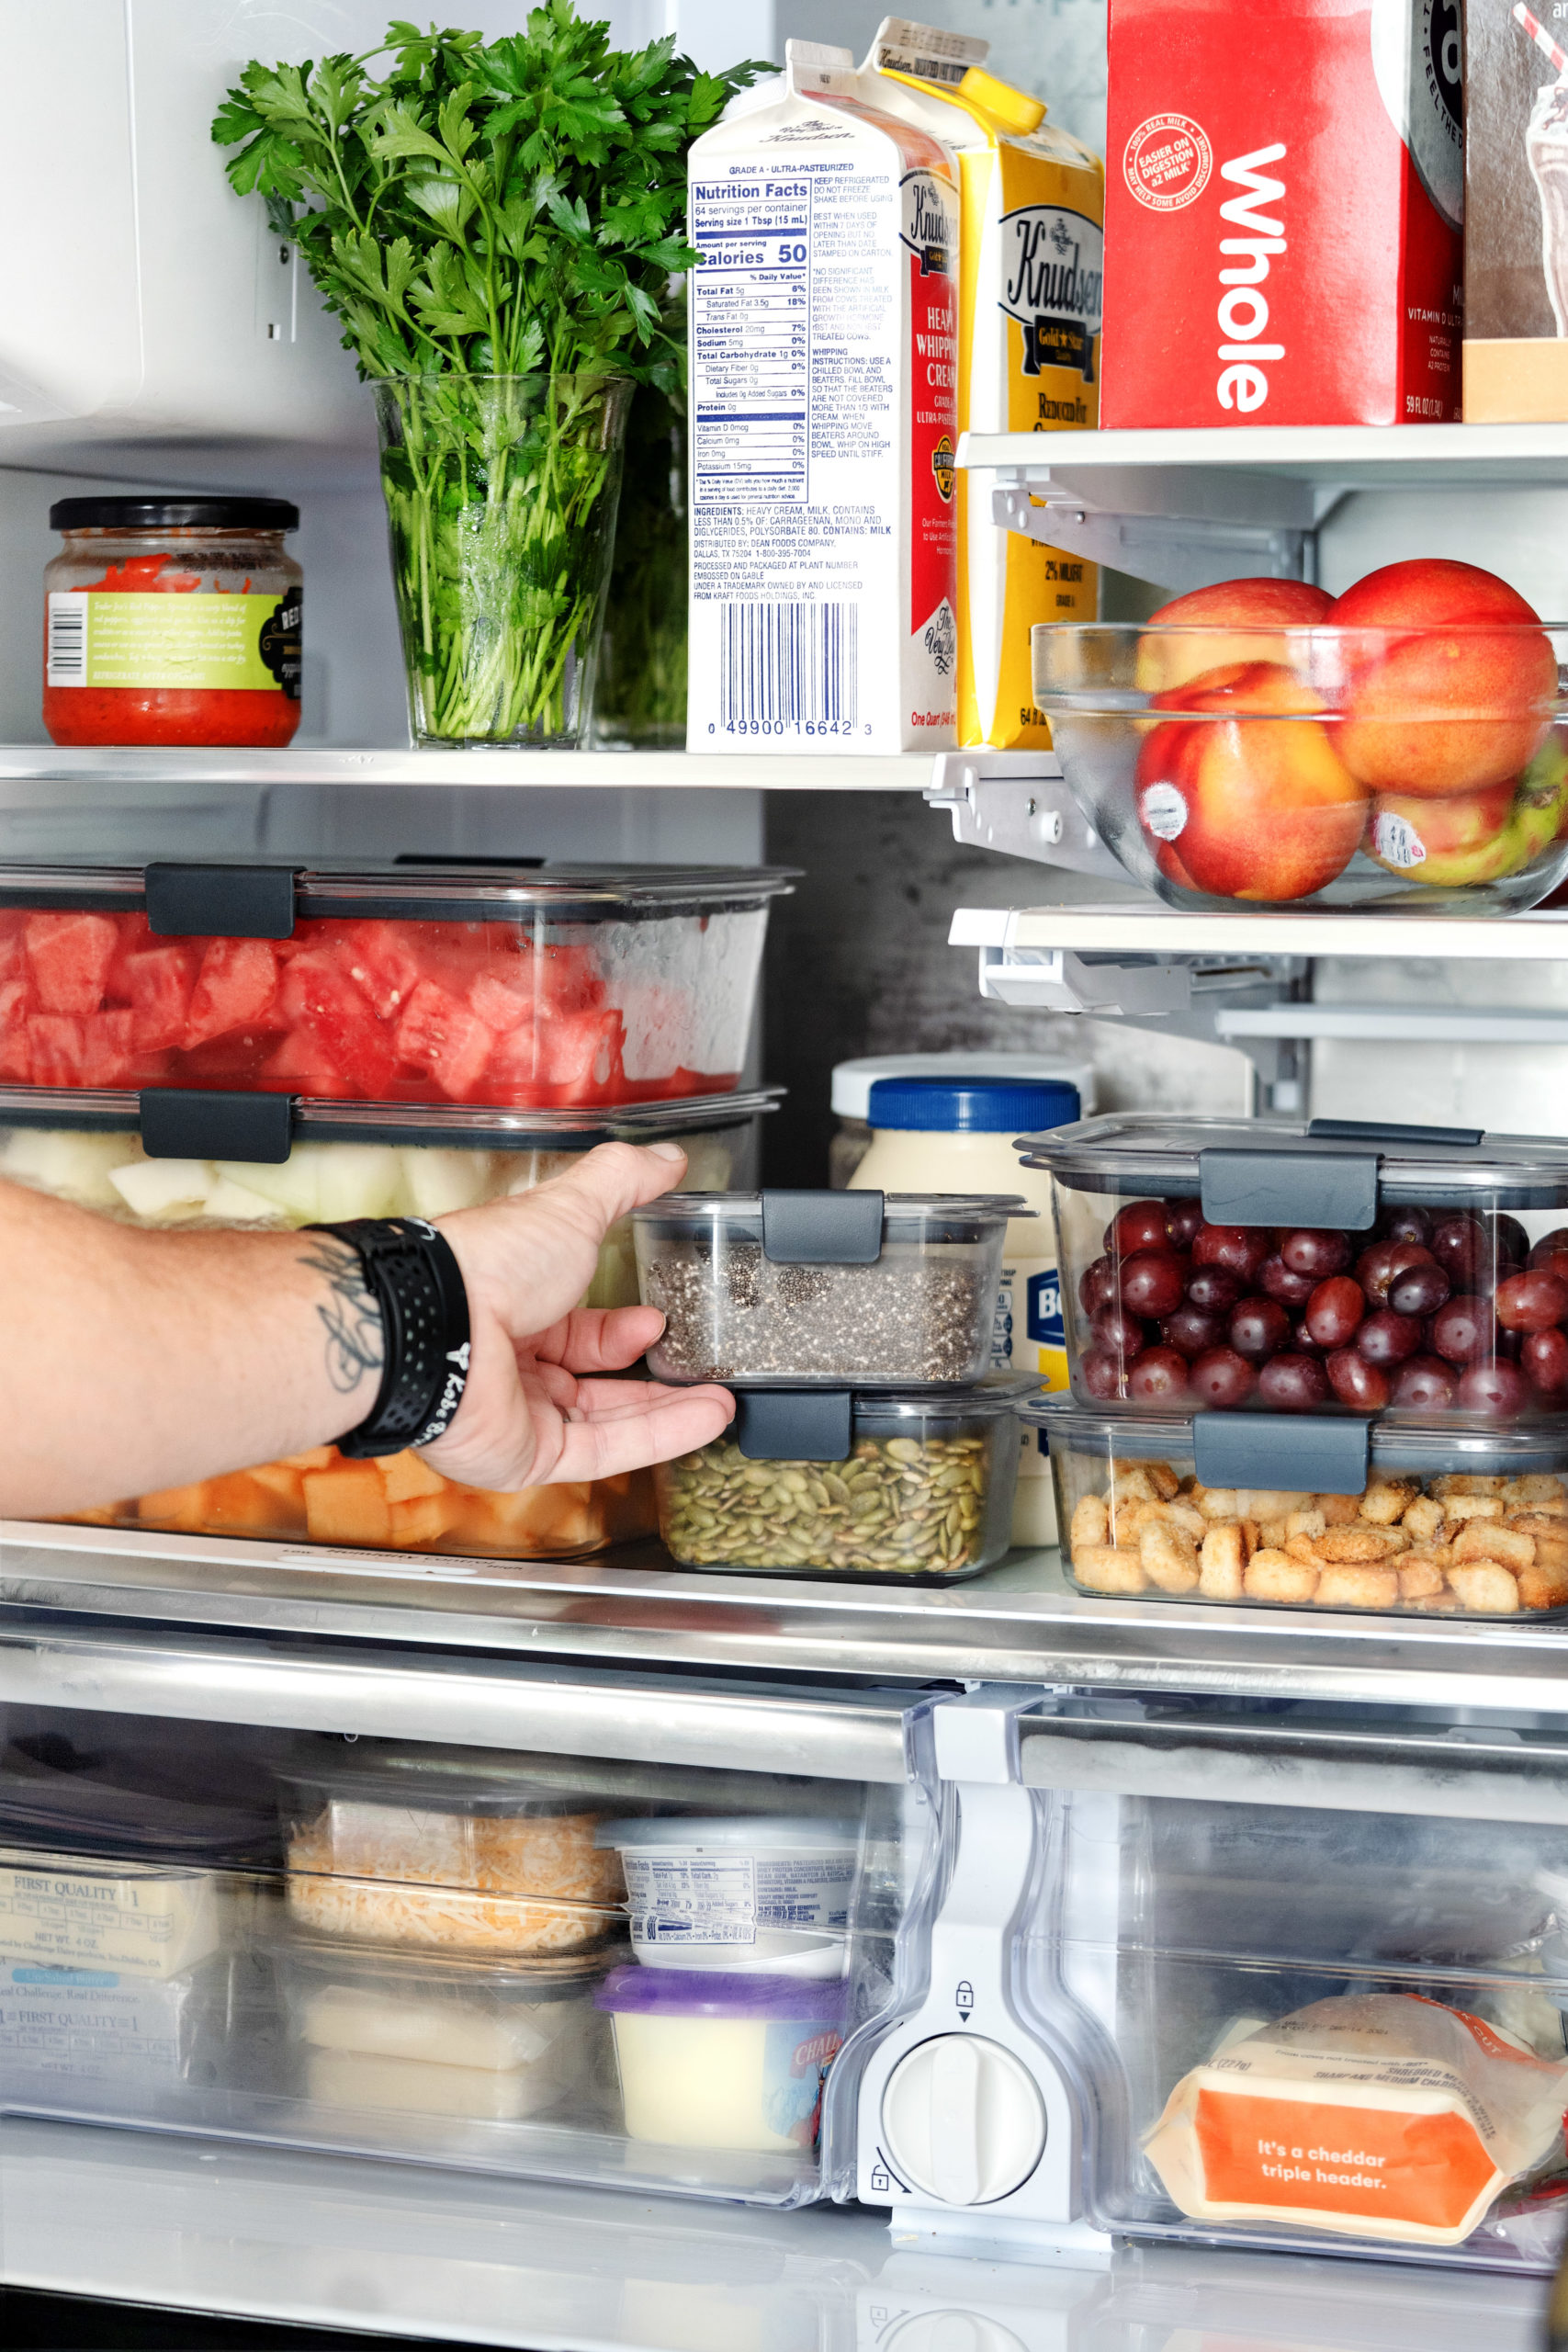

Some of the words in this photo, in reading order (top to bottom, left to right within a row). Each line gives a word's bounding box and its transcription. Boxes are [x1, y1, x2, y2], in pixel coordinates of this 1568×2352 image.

[1131, 130, 1146, 150] 100%
[1145, 119, 1165, 131] REAL
[1168, 118, 1188, 128] MILK
[1139, 145, 1173, 168] EASIER
[1174, 137, 1190, 152] ON
[729, 166, 757, 175] GRADE
[771, 164, 854, 174] ULTRA-PASTEURIZED
[1142, 148, 1193, 179] DIGESTION
[1128, 167, 1138, 186] MAY
[1135, 186, 1151, 201] HELP
[1152, 198, 1173, 207] SOME
[1176, 187, 1197, 205] AVOID
[1195, 135, 1209, 188] DISCOMFORT
[1151, 175, 1164, 187] a2
[695, 185, 760, 200] Nutrition
[765, 183, 807, 197] Facts
[695, 207, 705, 215] 64
[708, 205, 745, 215] servings
[748, 206, 761, 214] per
[765, 204, 807, 212] container
[695, 219, 724, 228] Serving
[745, 217, 748, 225] 1
[752, 216, 772, 226] Tbsp
[775, 215, 788, 226] (15
[791, 215, 807, 225] mL)
[778, 244, 807, 263] 50
[1008, 219, 1101, 317] Knudsen
[1216, 142, 1286, 413] Whole
[697, 288, 717, 296] Total
[706, 300, 739, 309] Saturated
[754, 299, 769, 308] 3.5g
[706, 312, 725, 321] Trans
[727, 312, 738, 321] Fat
[1408, 308, 1440, 323] VITAMIN
[1442, 312, 1446, 324] D
[696, 326, 743, 334] Cholesterol
[1039, 327, 1059, 347] Gold
[697, 339, 727, 347] Sodium
[728, 339, 743, 347] 5mg
[720, 350, 776, 359] Carbohydrate
[780, 350, 788, 359] 1g
[705, 365, 728, 373] Dietary
[730, 364, 748, 372] Fiber
[724, 377, 748, 385] Sugars
[767, 390, 787, 399] Sugars
[1406, 396, 1414, 413] 59
[1416, 396, 1421, 414] FL
[1423, 396, 1428, 415] OZ
[712, 450, 726, 458] 0mg
[733, 462, 751, 470] 15mg
[694, 507, 744, 516] INGREDIENTS:
[746, 506, 772, 515] HEAVY
[773, 505, 805, 515] CREAM,
[870, 526, 891, 535] MILK
[751, 539, 770, 548] DEAN
[772, 539, 796, 548] FOODS
[722, 549, 729, 558] TX
[1044, 560, 1058, 582] 2%
[911, 711, 925, 726] One
[926, 711, 940, 727] Quart
[1021, 707, 1031, 726] 64
[708, 723, 715, 734] 0
[727, 720, 784, 735] 49900
[795, 720, 852, 735] 16642
[864, 724, 873, 736] 3
[435, 1373, 466, 1419] Kobe
[14, 1875, 51, 1892] FIRST
[54, 1882, 117, 1901] QUALITY
[18, 2011, 56, 2023] FIRST
[1473, 2025, 1501, 2054] CUT
[1258, 2139, 1286, 2157] It's
[1291, 2147, 1303, 2158] a
[1308, 2147, 1385, 2167] cheddar
[1261, 2164, 1311, 2182] triple
[1315, 2168, 1386, 2188] header.
